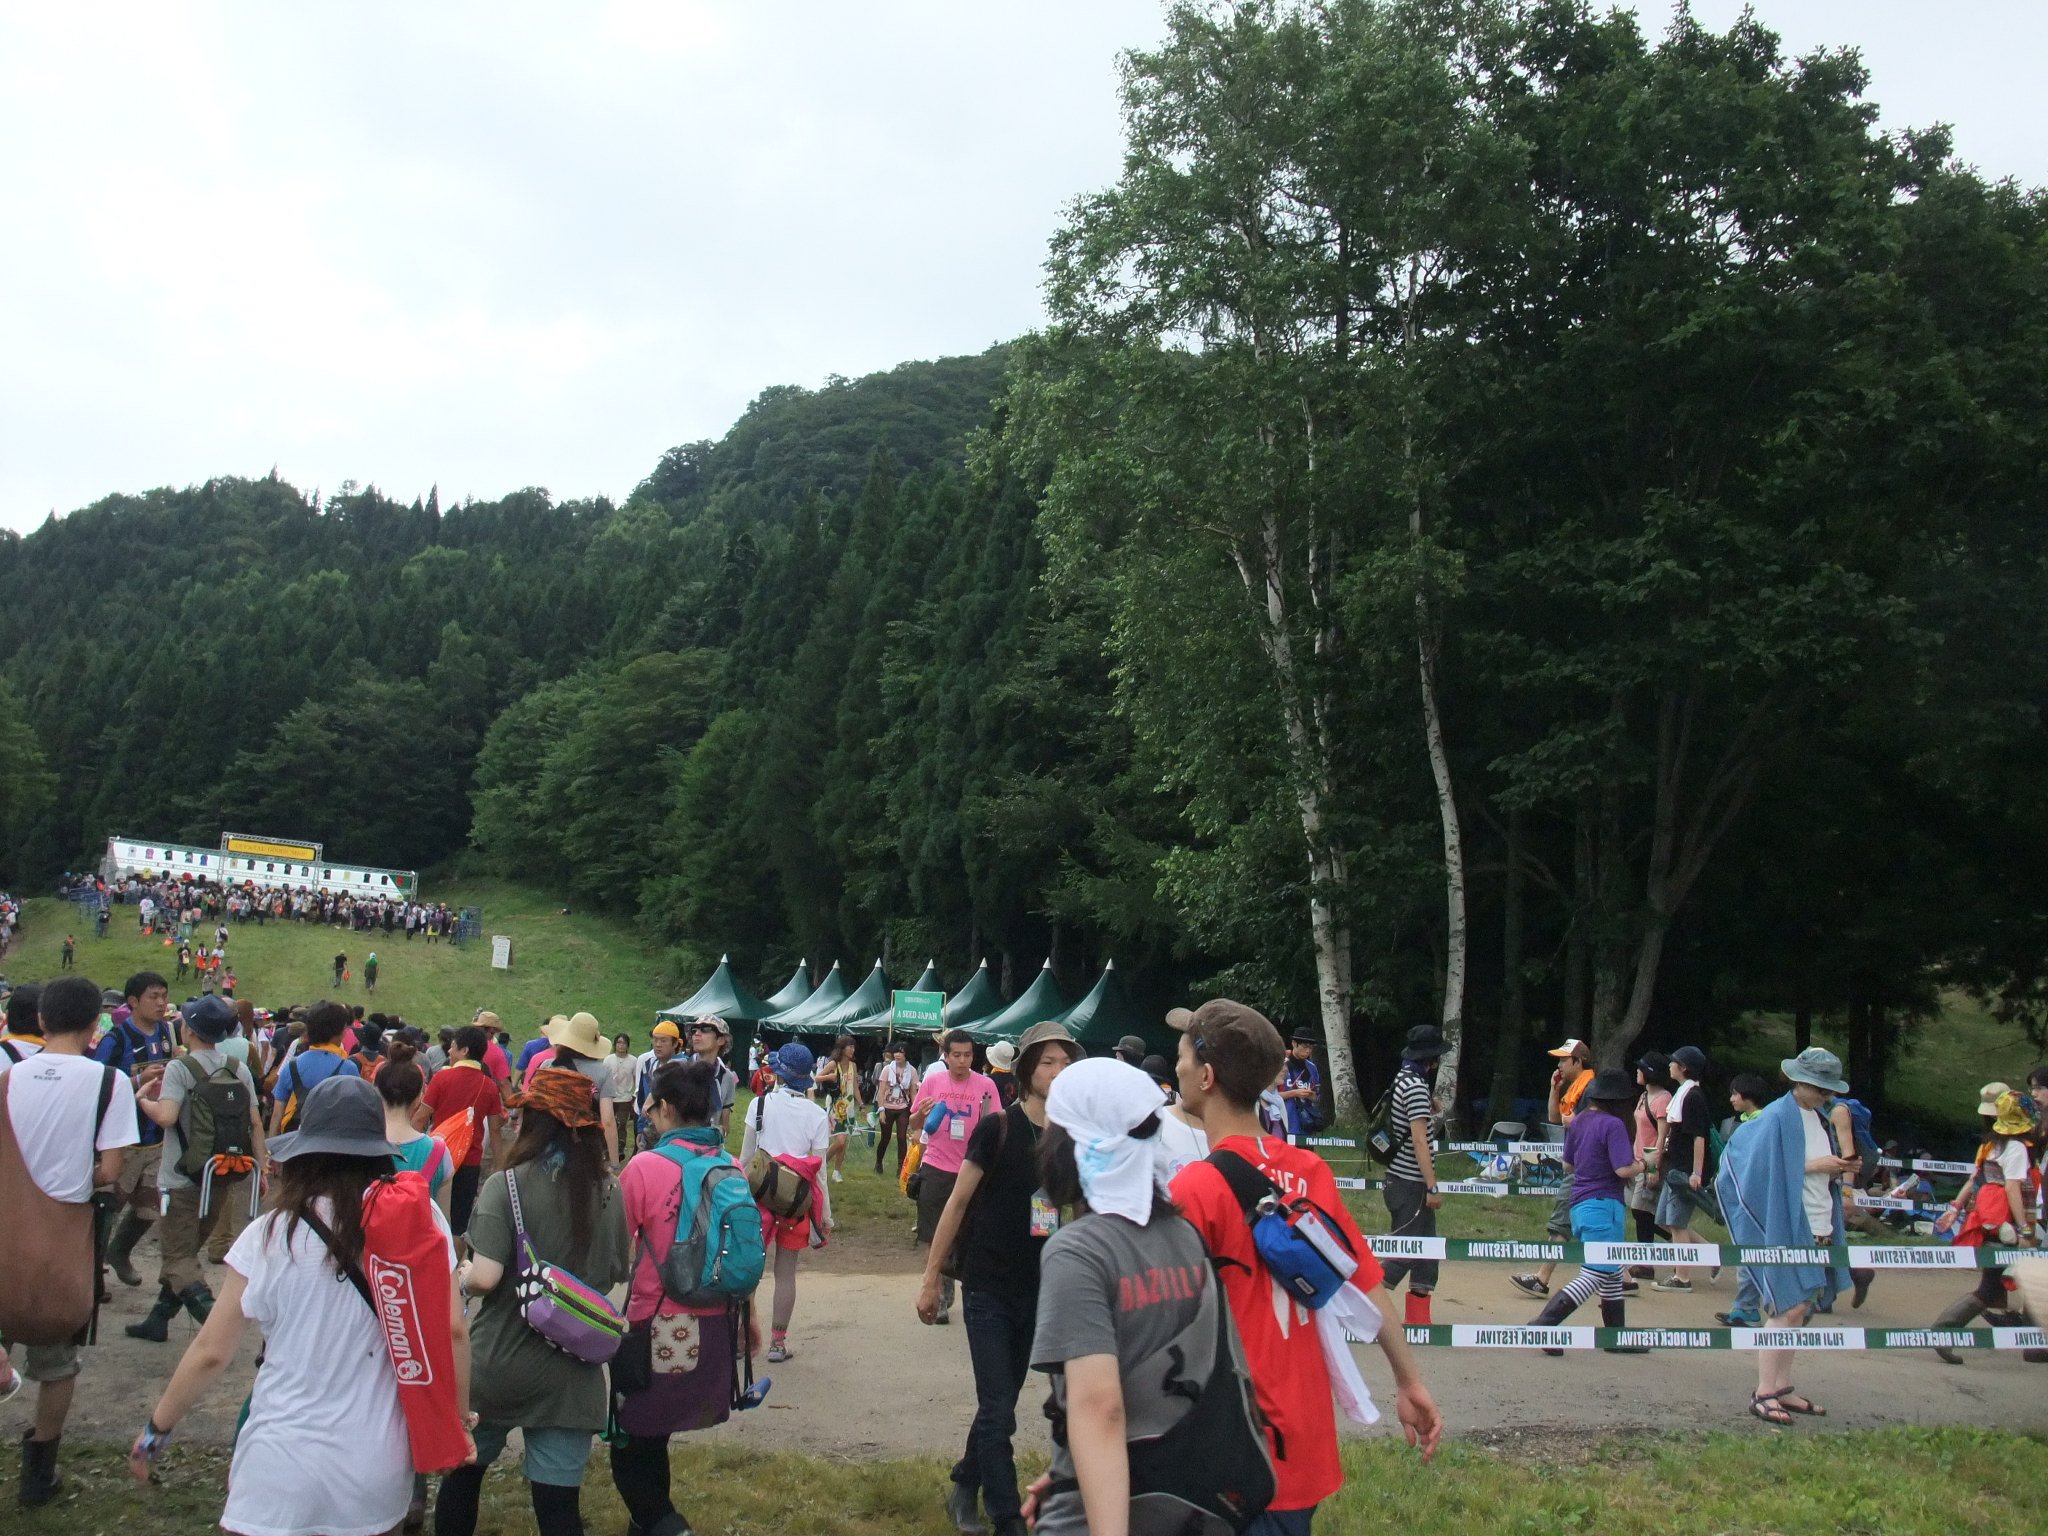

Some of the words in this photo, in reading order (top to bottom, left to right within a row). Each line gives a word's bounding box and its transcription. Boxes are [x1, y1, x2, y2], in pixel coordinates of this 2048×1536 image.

[897, 1010, 902, 1018] A
[902, 1010, 918, 1018] SEED
[918, 1012, 938, 1021] JAPAN
[1306, 1137, 1318, 1146] FUJI
[1319, 1137, 1333, 1146] ROCK
[1334, 1138, 1356, 1148] FESTIVAL
[1449, 1142, 1460, 1150] FUJI
[1461, 1143, 1475, 1151] ROCK
[1475, 1143, 1498, 1151] FESTIVAL
[1520, 1144, 1531, 1152] FUJI
[1532, 1144, 1545, 1152] ROCK
[1447, 1184, 1459, 1192] FUJI
[1474, 1185, 1497, 1194] FESTIVAL
[1519, 1186, 1530, 1194] FUJI
[378, 1270, 412, 1358] Coleman
